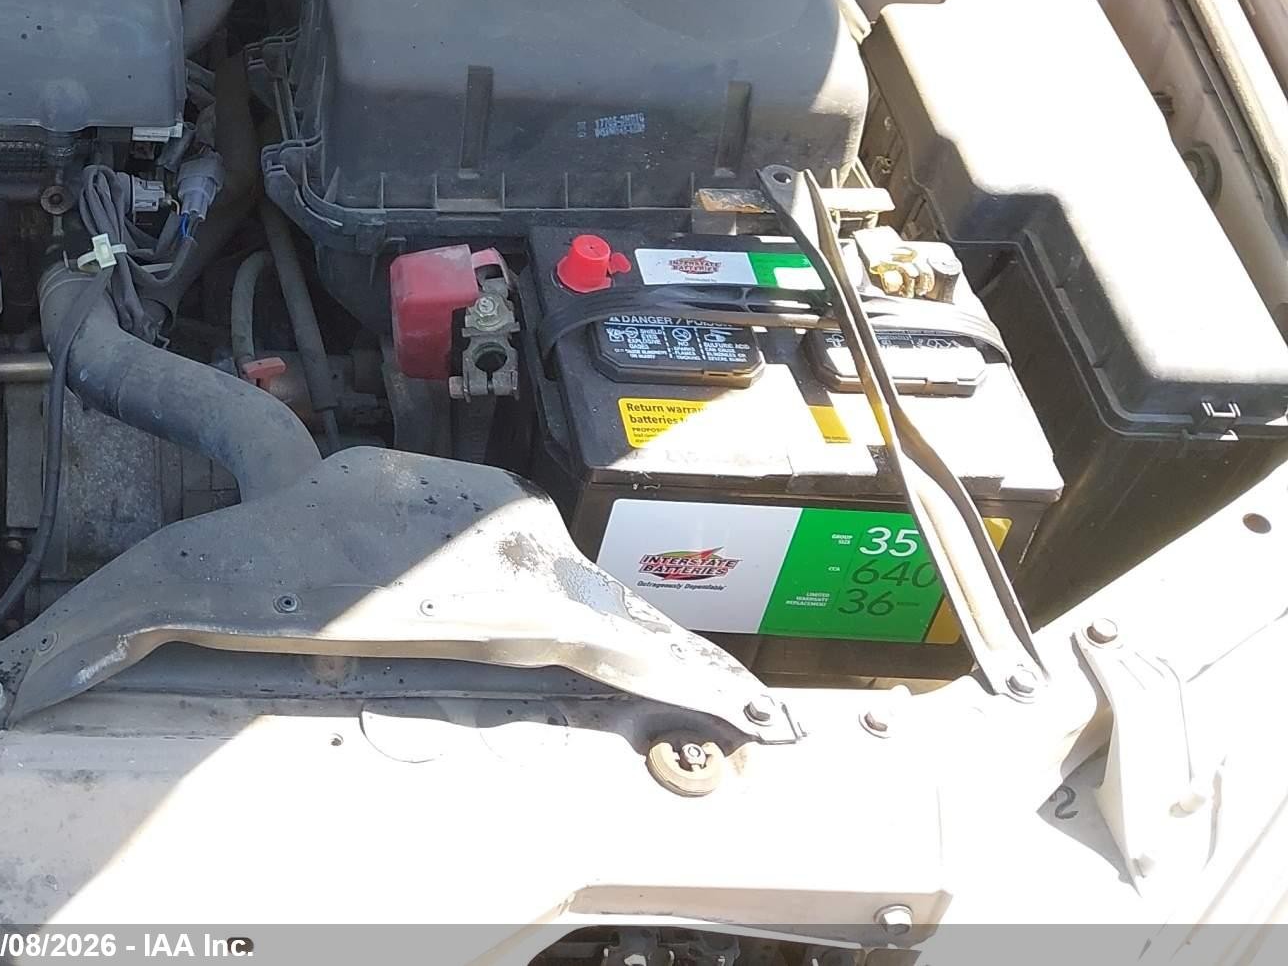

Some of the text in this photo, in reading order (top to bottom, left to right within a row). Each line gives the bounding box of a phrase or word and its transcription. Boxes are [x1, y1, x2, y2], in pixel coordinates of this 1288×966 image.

[621, 315, 673, 325] DANGER
[626, 402, 664, 412] Return
[630, 415, 678, 425] batteries
[859, 526, 920, 557] 35
[641, 554, 740, 569] INTERSTATE
[641, 564, 728, 575] BATTERIES
[851, 559, 939, 588] 640
[637, 580, 724, 591] Outrageously Dependable
[838, 588, 895, 616] 36
